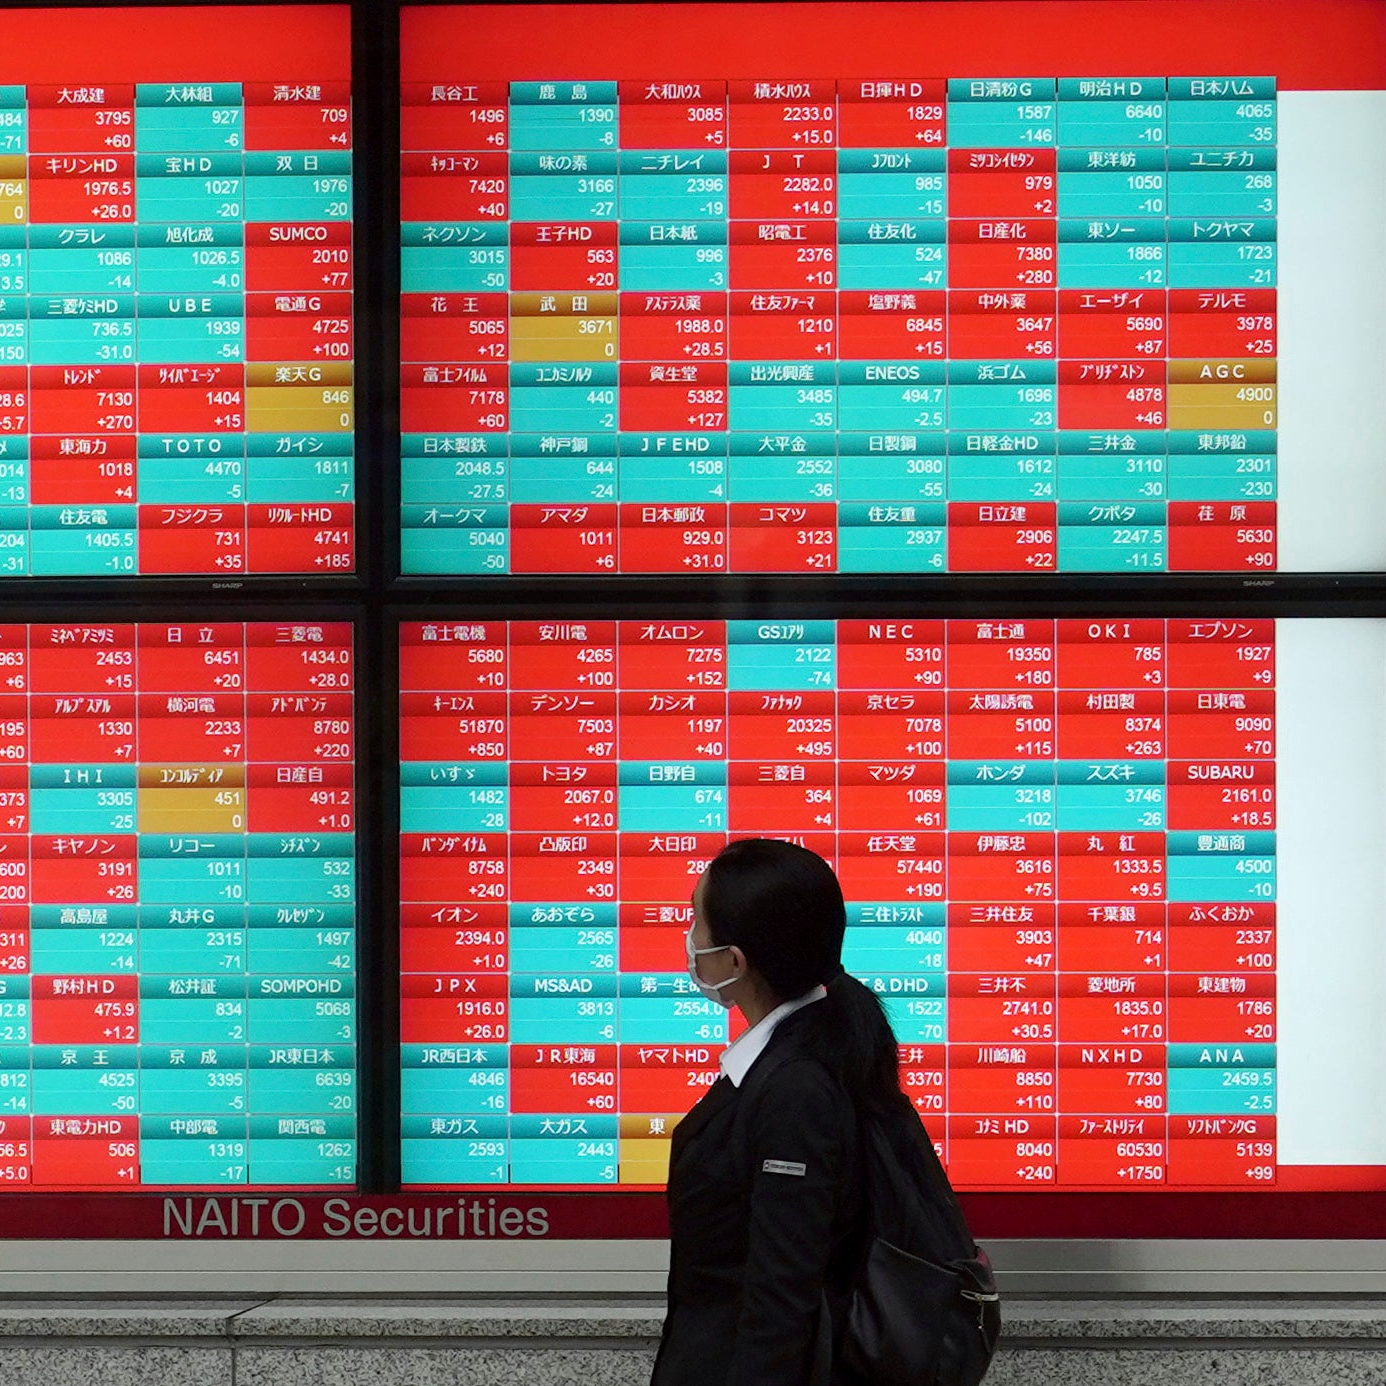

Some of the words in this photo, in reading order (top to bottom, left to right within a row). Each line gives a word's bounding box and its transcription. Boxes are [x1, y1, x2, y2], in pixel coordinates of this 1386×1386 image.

[166, 87, 212, 102] 大林組
[432, 86, 477, 101] 長谷工
[1191, 81, 1253, 95] 日本ハム
[58, 89, 104, 103] 大成建
[212, 110, 238, 124] 927
[470, 110, 504, 122] 1496
[1236, 104, 1272, 117] 4065
[96, 111, 130, 125] 3795
[105, 134, 131, 147] +60
[225, 133, 239, 146] -6
[487, 132, 504, 145] +6
[1249, 127, 1272, 141] -35
[47, 159, 117, 173] キリンHD
[540, 155, 587, 171] 味の素
[84, 182, 131, 195] 1976.5
[578, 179, 613, 192] 3166
[92, 205, 131, 218] +26.0
[591, 202, 614, 215] -27
[270, 227, 327, 240] SUMCO
[537, 226, 591, 241] 王子HD
[979, 223, 1026, 238] 日産化
[1194, 222, 1254, 237] トクヤマ
[313, 250, 348, 263] 2010
[588, 250, 614, 263] 563
[1017, 247, 1052, 260] 7380
[1238, 245, 1272, 259] 1723
[322, 273, 348, 285] +77
[587, 273, 614, 286] +20
[1017, 270, 1052, 283] +280
[1249, 269, 1270, 283] -21
[1081, 293, 1143, 308] エーザイ
[1127, 317, 1162, 330] 5690
[1136, 340, 1162, 353] +87
[866, 366, 919, 379] ENEOS
[902, 389, 942, 402] 494.7
[915, 412, 942, 426] -2.5
[425, 438, 486, 453] 日本製鉄
[456, 462, 504, 475] 2048.5
[468, 485, 504, 498] -27.5
[163, 509, 222, 523] フジクラ
[643, 506, 704, 522] 日本郵政
[760, 508, 806, 521] コマツ
[215, 532, 239, 545] 731
[683, 531, 723, 544] 929.0
[798, 531, 832, 544] 3123
[216, 555, 241, 568] +35
[683, 554, 723, 567] +31.0
[806, 554, 831, 567] +21
[641, 625, 703, 639] オムロン
[687, 648, 722, 662] 7275
[687, 672, 722, 685] +152
[278, 767, 322, 782] 日産自
[544, 766, 586, 781] トヨタ
[977, 764, 1026, 780] ホンダ
[1188, 766, 1253, 779] SUBARU
[310, 791, 349, 804] 491.2
[565, 790, 613, 803] 2067.0
[1016, 789, 1051, 803] 3218
[1222, 789, 1272, 802] 2161.0
[319, 814, 350, 827] +1.0
[573, 813, 613, 826] +12.0
[1019, 812, 1051, 825] -102
[1232, 812, 1272, 825] +18.5
[53, 839, 115, 853] キヤノン
[867, 836, 916, 852] 任天堂
[98, 862, 131, 876] 3191
[898, 860, 942, 873] 57440
[107, 885, 133, 898] +26
[906, 883, 942, 896] +190
[432, 907, 478, 922] イオン
[1190, 906, 1254, 921] ふくおか
[456, 931, 504, 945] 2394.0
[1236, 931, 1272, 944] 2337
[473, 954, 504, 967] +1.0
[1236, 954, 1272, 967] +100
[261, 979, 341, 993] SOMPOHD
[535, 979, 592, 992] MS&AD
[315, 1003, 351, 1016] 5068
[578, 1002, 613, 1015] 3813
[337, 1025, 351, 1038] -3
[599, 1025, 613, 1038] -6
[269, 1048, 334, 1064] JR東日本
[422, 1048, 487, 1063] JR西日本
[316, 1073, 351, 1086] 6639
[469, 1072, 504, 1085] 4846
[329, 1096, 351, 1109] -20
[481, 1095, 504, 1108] -16
[171, 1120, 218, 1134] 中部電
[431, 1118, 478, 1134] 東ガス
[209, 1144, 243, 1157] 1319
[469, 1142, 504, 1156] 2593
[221, 1166, 243, 1179] -17
[490, 1166, 503, 1179] -1
[164, 1198, 305, 1235] NAITO
[324, 1198, 548, 1235] Securities
